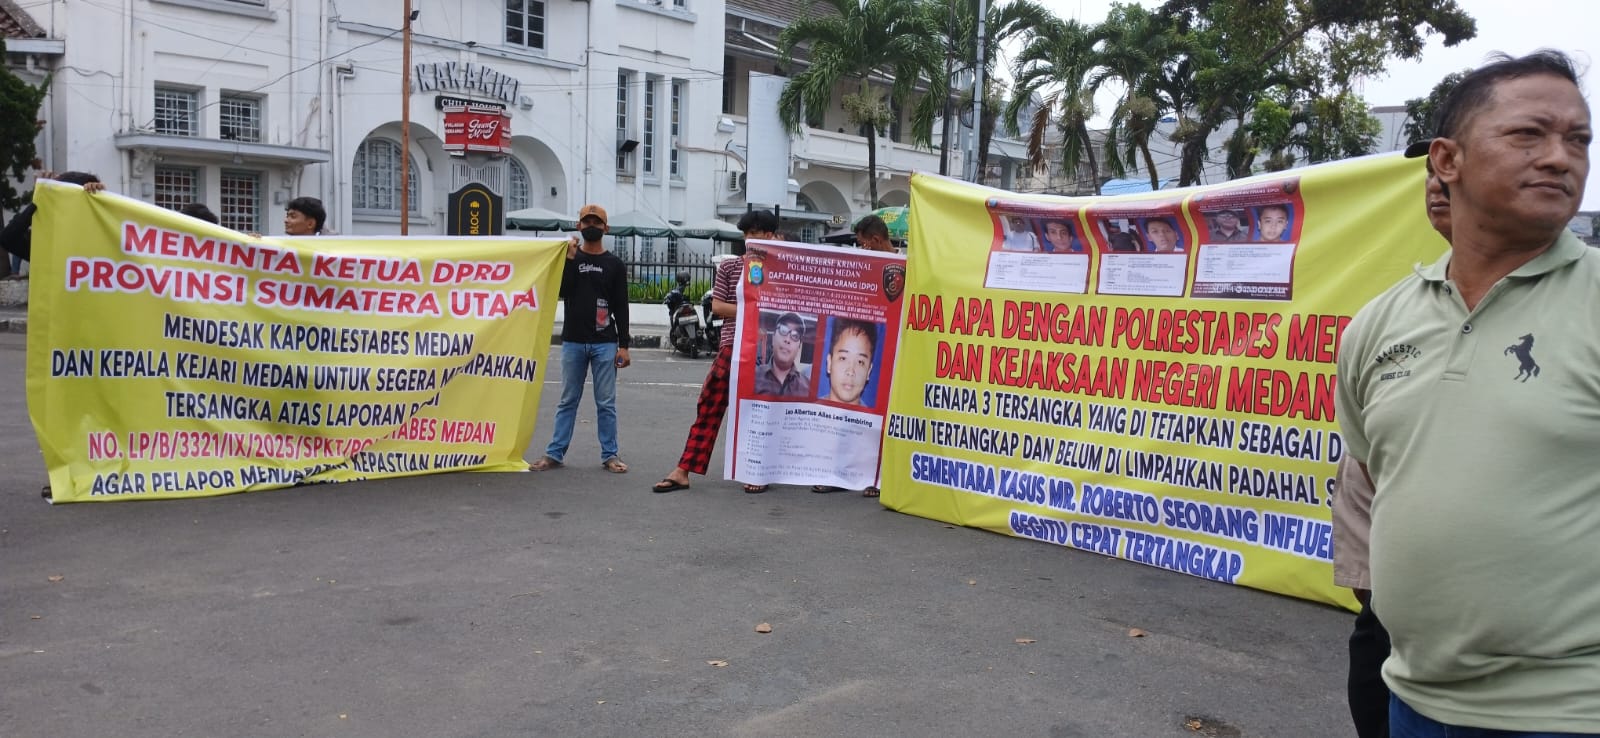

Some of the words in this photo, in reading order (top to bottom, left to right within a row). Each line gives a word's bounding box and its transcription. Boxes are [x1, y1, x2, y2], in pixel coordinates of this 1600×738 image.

[124, 224, 300, 274] MEMINTA
[313, 252, 420, 283] KETUA
[433, 263, 511, 283] DPRD
[777, 253, 805, 264] SATUAN
[805, 255, 834, 267] RESERSE
[836, 259, 872, 271] KRIMINAL
[787, 263, 834, 275] POLRESTABES
[835, 268, 861, 278] MEDAN
[69, 260, 245, 303] PROVINSI
[257, 280, 440, 315] SUMATERA
[768, 271, 794, 281] DAFTAR
[795, 273, 833, 286] PENCARIAN
[834, 279, 858, 290] ORANG
[859, 281, 878, 292] (DPO)
[164, 313, 265, 348] MENDESAK
[270, 325, 410, 356] KAPORLESTABES
[415, 331, 473, 357] MEDAN
[906, 294, 945, 333] ADA
[950, 297, 995, 337] APA
[1001, 300, 1108, 347] DENGAN
[1111, 307, 1282, 359] POLRESTABES
[52, 350, 93, 377] DAN
[99, 350, 170, 378] KEPALA
[176, 354, 237, 384] KEJARI
[243, 361, 308, 390] MEDAN
[314, 366, 371, 391] UNTUK
[376, 368, 436, 392] SEGERA
[1375, 344, 1421, 364] MAJESTIC
[936, 341, 984, 382] DAN
[989, 346, 1129, 400] KEJAKSAAN
[1132, 360, 1222, 410] NEGERI
[1226, 367, 1337, 423] MEDAN
[165, 392, 272, 421] TERSANGKA
[279, 402, 321, 427] ATAS
[326, 403, 406, 427] LAPORAN
[794, 408, 817, 417] Albertus
[818, 411, 832, 420] Alias
[844, 416, 873, 428] Sembiring
[925, 384, 978, 413] KENAPA
[982, 391, 991, 415] 3
[996, 393, 1082, 428] TERSANGKA
[1088, 403, 1127, 433] YANG
[1130, 409, 1147, 437] DI
[1151, 412, 1235, 448] TETAPKAN
[1239, 422, 1322, 461] SEBAGAI
[89, 432, 123, 460] NO.
[440, 420, 496, 445] MEDAN
[888, 414, 926, 442] BELUM
[931, 421, 1018, 456] TERTANGKAP
[1022, 435, 1054, 463] DAN
[1055, 441, 1103, 471] BELUM
[1104, 448, 1120, 476] DI
[1125, 451, 1222, 491] LIMPAHKAN
[1229, 467, 1319, 504] PADAHAL
[91, 474, 145, 496] AGAR
[152, 467, 234, 492] PELAPOR
[351, 451, 430, 473] KEPASTIAN
[912, 454, 995, 496] SEMENTARA
[998, 469, 1045, 504] KASUS
[1049, 478, 1076, 511] MR.
[1081, 485, 1158, 523] ROBERTO
[1163, 499, 1258, 541] SEORANG
[1263, 514, 1334, 560] INFLUE
[1010, 512, 1067, 544] BEGITU
[1071, 522, 1121, 556] CEPAT
[1125, 533, 1240, 584] TERTANGKAP
